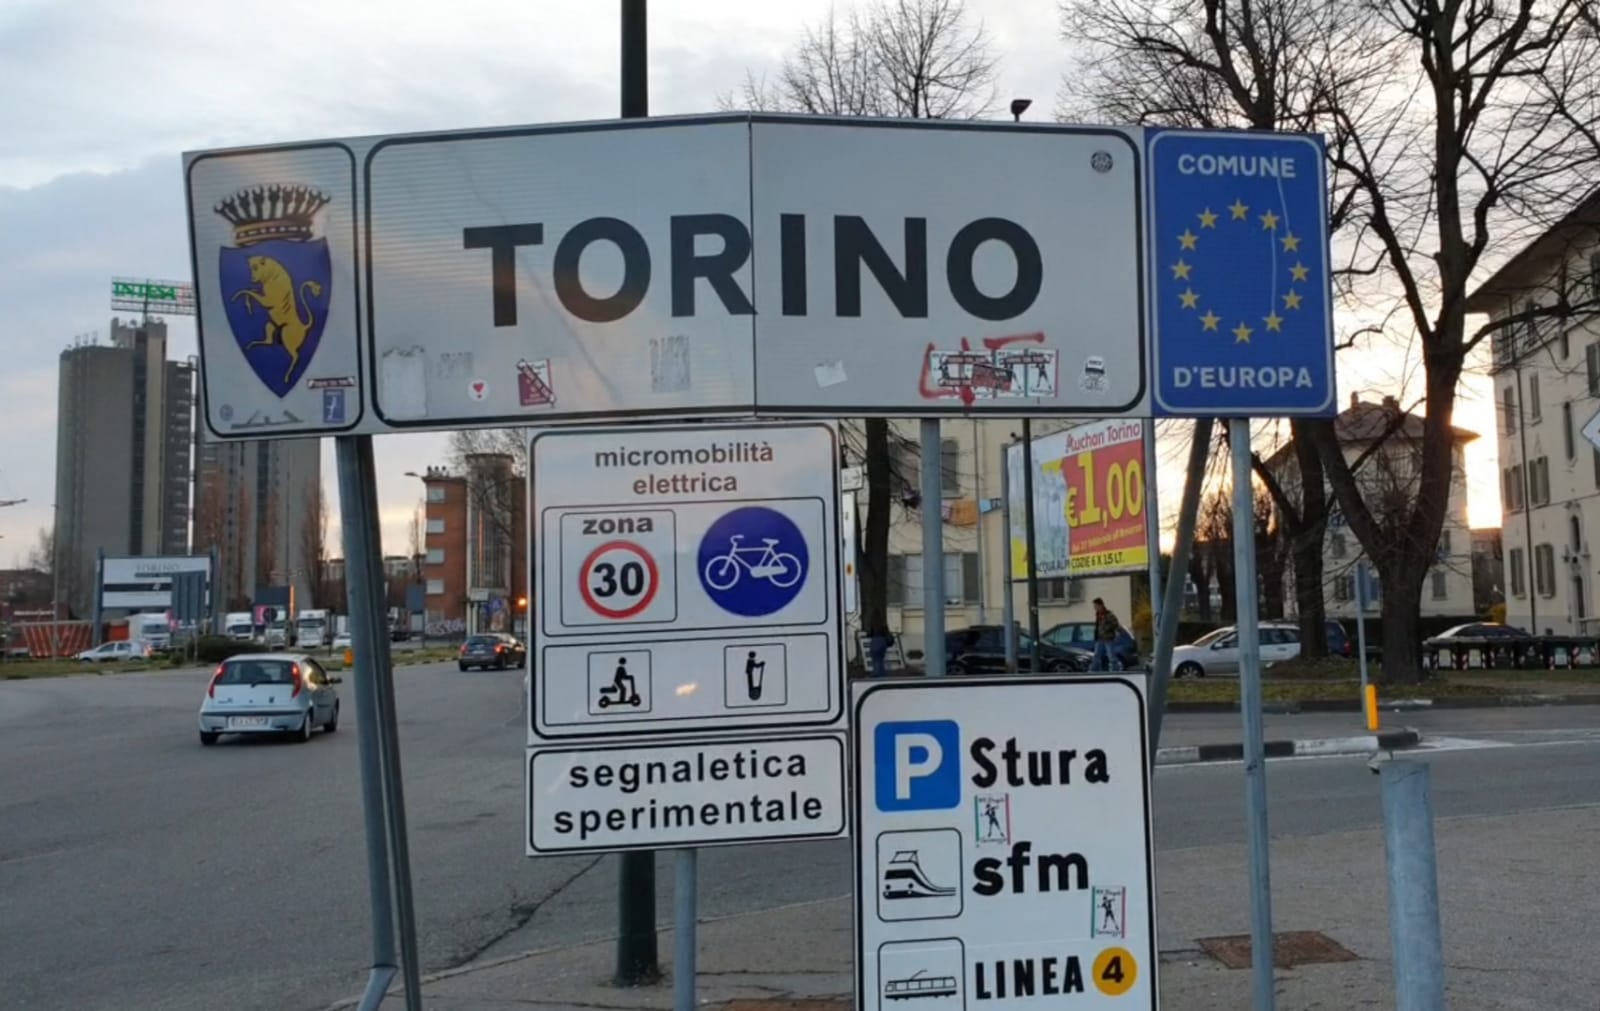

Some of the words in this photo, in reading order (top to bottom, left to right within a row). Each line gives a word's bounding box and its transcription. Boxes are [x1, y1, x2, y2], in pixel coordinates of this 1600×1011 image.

[1178, 153, 1296, 178] COMUNE
[463, 212, 1043, 326] TORINO
[1173, 365, 1313, 389] D'EUROPA
[595, 441, 774, 467] micromobilità
[1066, 431, 1105, 453] Auchan
[1107, 423, 1141, 441] Torino
[633, 472, 738, 495] elettrica
[582, 515, 654, 535] zona
[593, 562, 645, 597] 30
[569, 750, 806, 793] segnaletica
[895, 733, 943, 800] P
[970, 737, 1110, 789] Stura
[554, 791, 823, 840] sperimentale
[972, 841, 1089, 897] sfm
[975, 956, 1085, 1000] LINEA
[1101, 955, 1125, 984] 4
